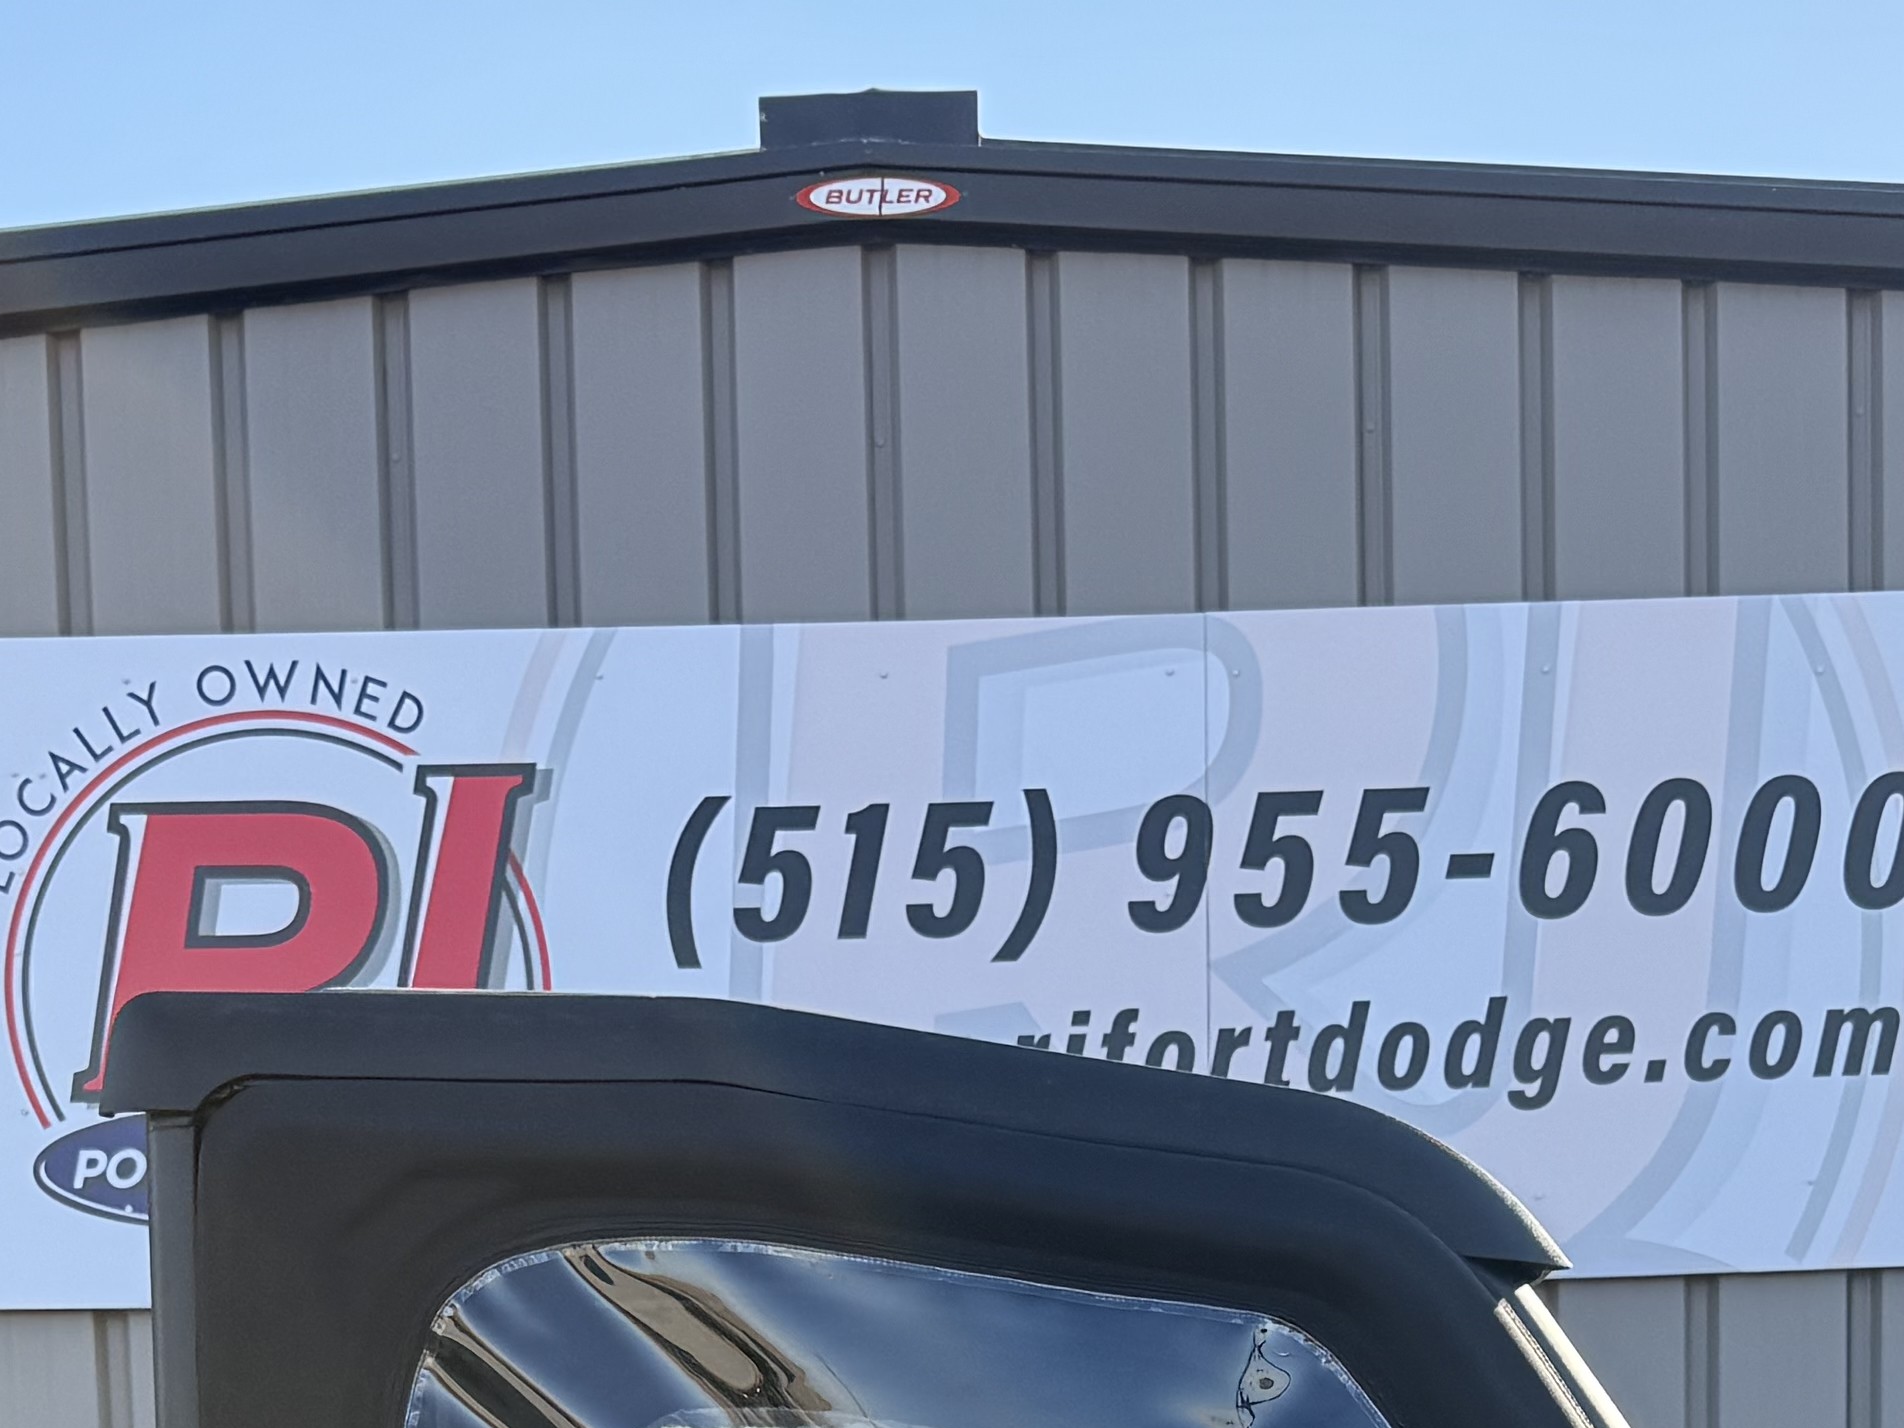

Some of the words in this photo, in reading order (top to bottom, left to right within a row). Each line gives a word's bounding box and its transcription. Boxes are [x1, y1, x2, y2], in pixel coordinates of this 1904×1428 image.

[825, 188, 934, 205] BUTLER
[196, 659, 425, 735] OWNED
[665, 789, 1059, 970] (515)
